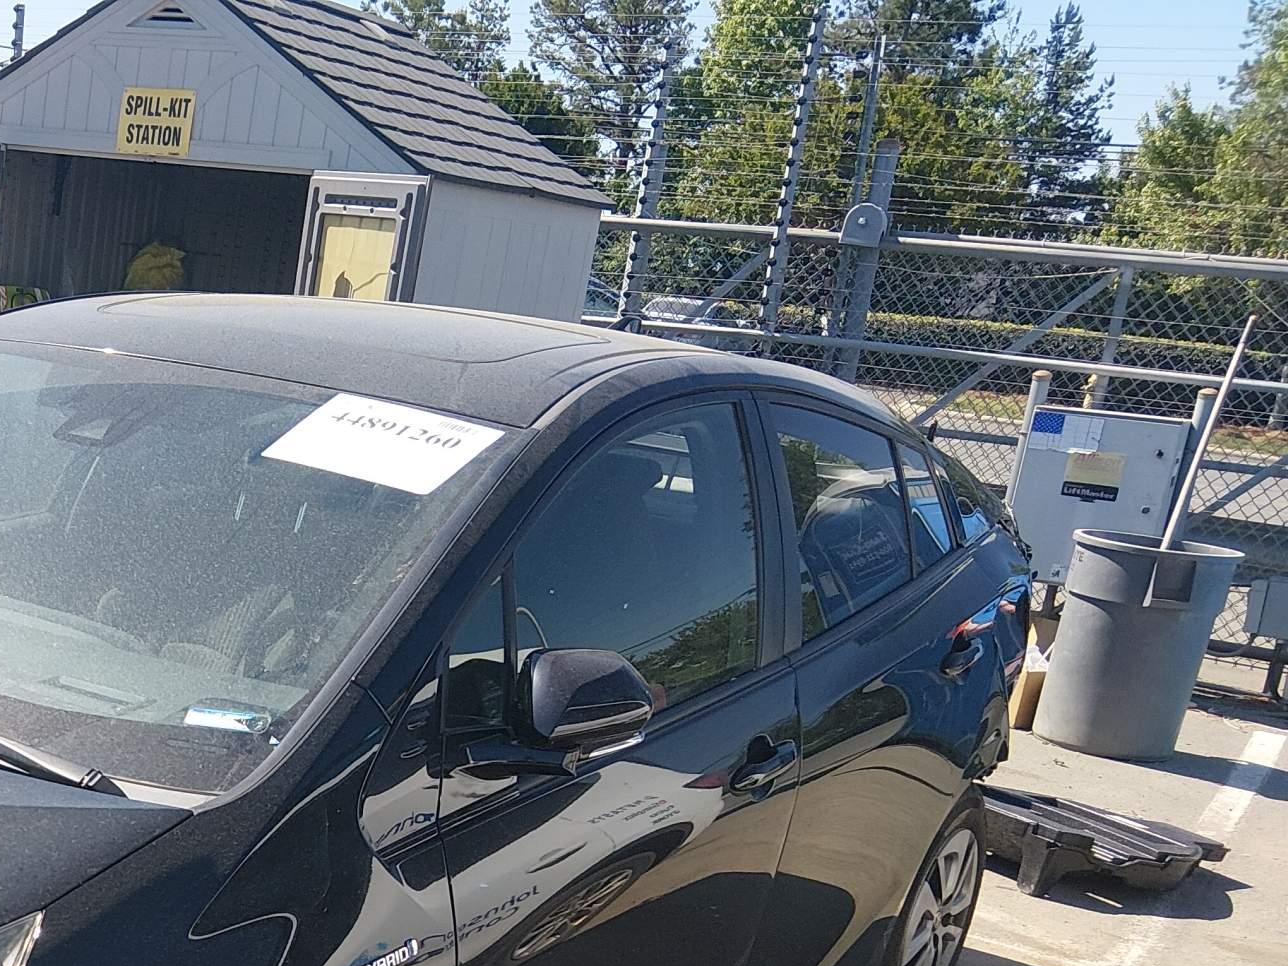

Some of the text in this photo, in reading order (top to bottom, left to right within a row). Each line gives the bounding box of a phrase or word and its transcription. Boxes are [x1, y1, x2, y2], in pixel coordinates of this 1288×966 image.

[125, 94, 192, 118] SPILL-KIT
[126, 123, 182, 147] STATION
[331, 411, 462, 449] 44891260
